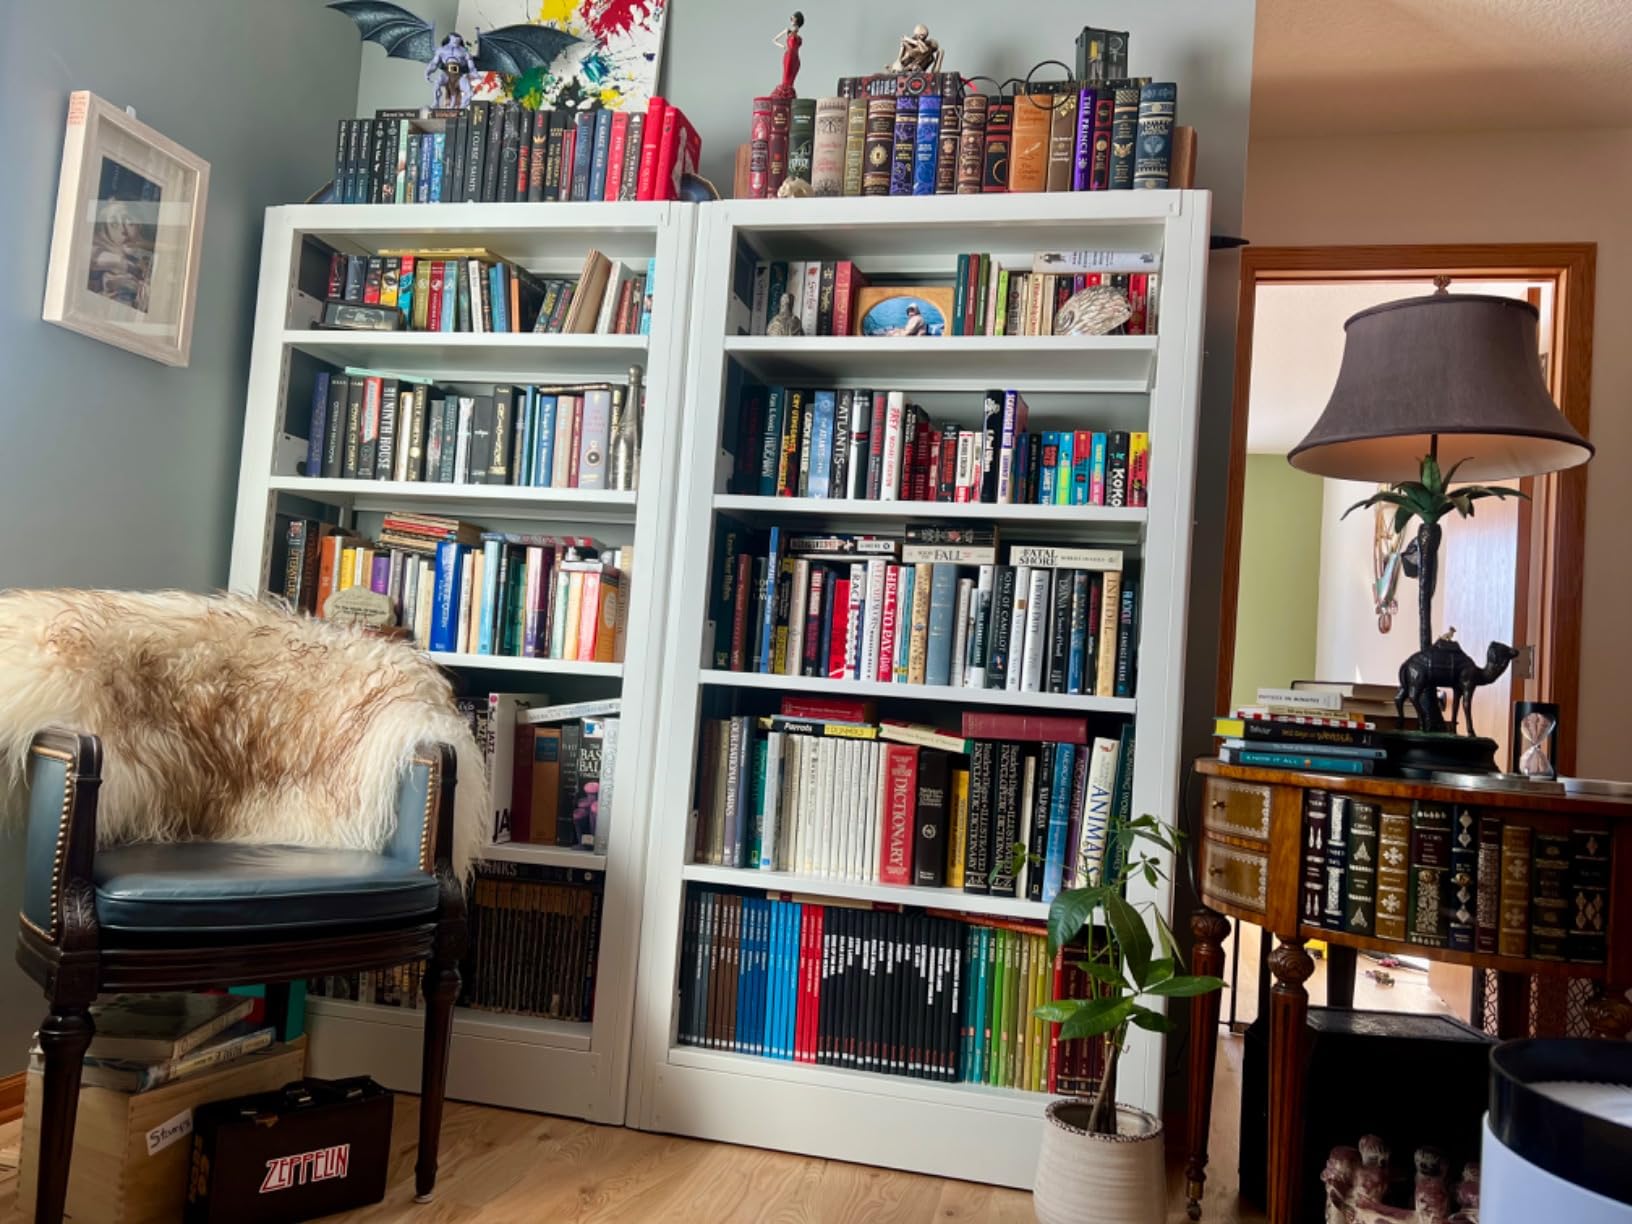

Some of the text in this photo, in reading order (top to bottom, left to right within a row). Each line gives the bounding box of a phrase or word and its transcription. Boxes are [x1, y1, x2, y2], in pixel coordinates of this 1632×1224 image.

[1078, 119, 1090, 155] PRINCE
[377, 401, 396, 470] NINTH HOUSE
[833, 405, 849, 465] ATLANTIS
[888, 407, 901, 431] PREY
[1111, 468, 1125, 507] KOKO
[933, 545, 965, 560] FALL
[879, 572, 898, 654] HELL TO PAY
[998, 571, 1013, 652] SONS OF CAMELOT
[1104, 579, 1118, 634] INFIDEL
[487, 730, 496, 755] JAZZ
[783, 721, 814, 733] Parrots
[727, 745, 740, 787] NATIONAL
[725, 789, 737, 817] PARKS
[888, 777, 909, 868] DICTIONARY
[1081, 785, 1112, 876] ANIMALS
[970, 815, 980, 871] DICTIONARY
[977, 808, 990, 872] ILLUSTRATED
[994, 816, 1007, 873] DICTIONAR
[1003, 810, 1016, 875] ILLUSTRATED
[258, 1143, 351, 1194] ZEPPELIN
